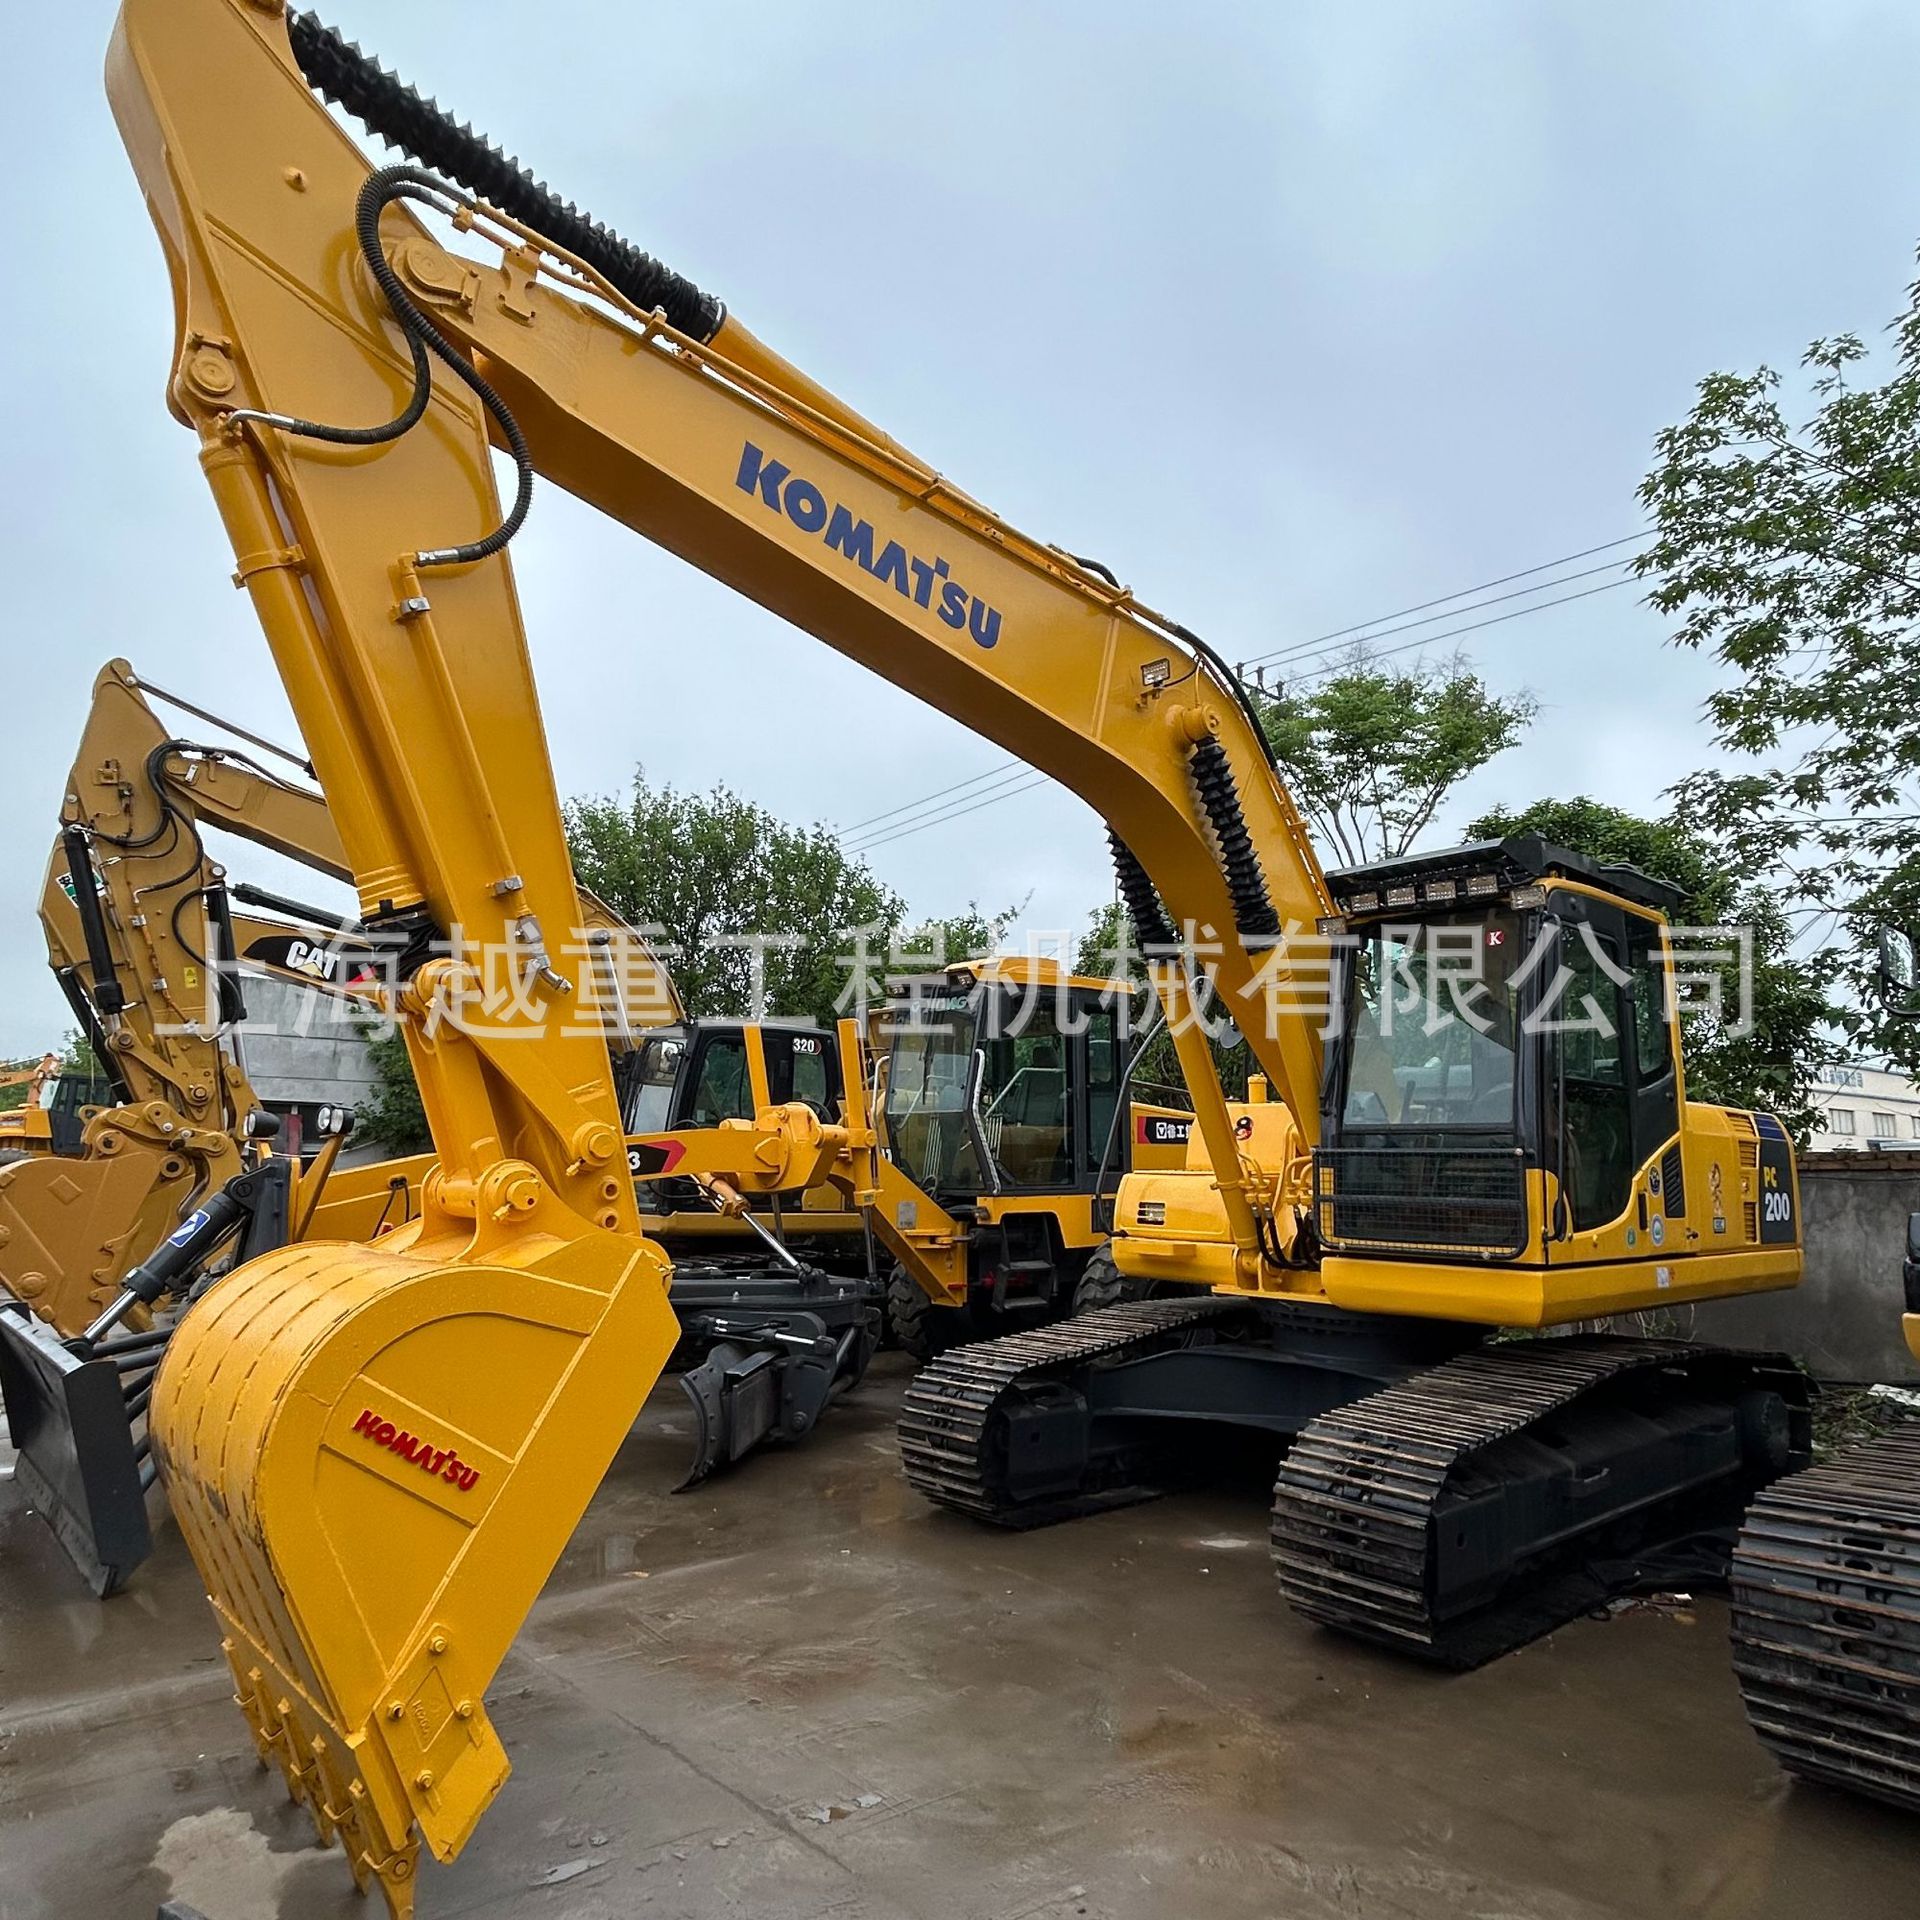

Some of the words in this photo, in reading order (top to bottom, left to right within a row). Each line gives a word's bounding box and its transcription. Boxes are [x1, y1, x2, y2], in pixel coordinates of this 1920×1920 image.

[736, 440, 1001, 649] KOMATSU
[1489, 931, 1502, 946] K
[286, 941, 341, 980] CAT
[792, 1037, 815, 1053] 320
[1763, 1166, 1778, 1188] PC
[1765, 1192, 1791, 1222] 200
[352, 1409, 481, 1492] KOMATSU
